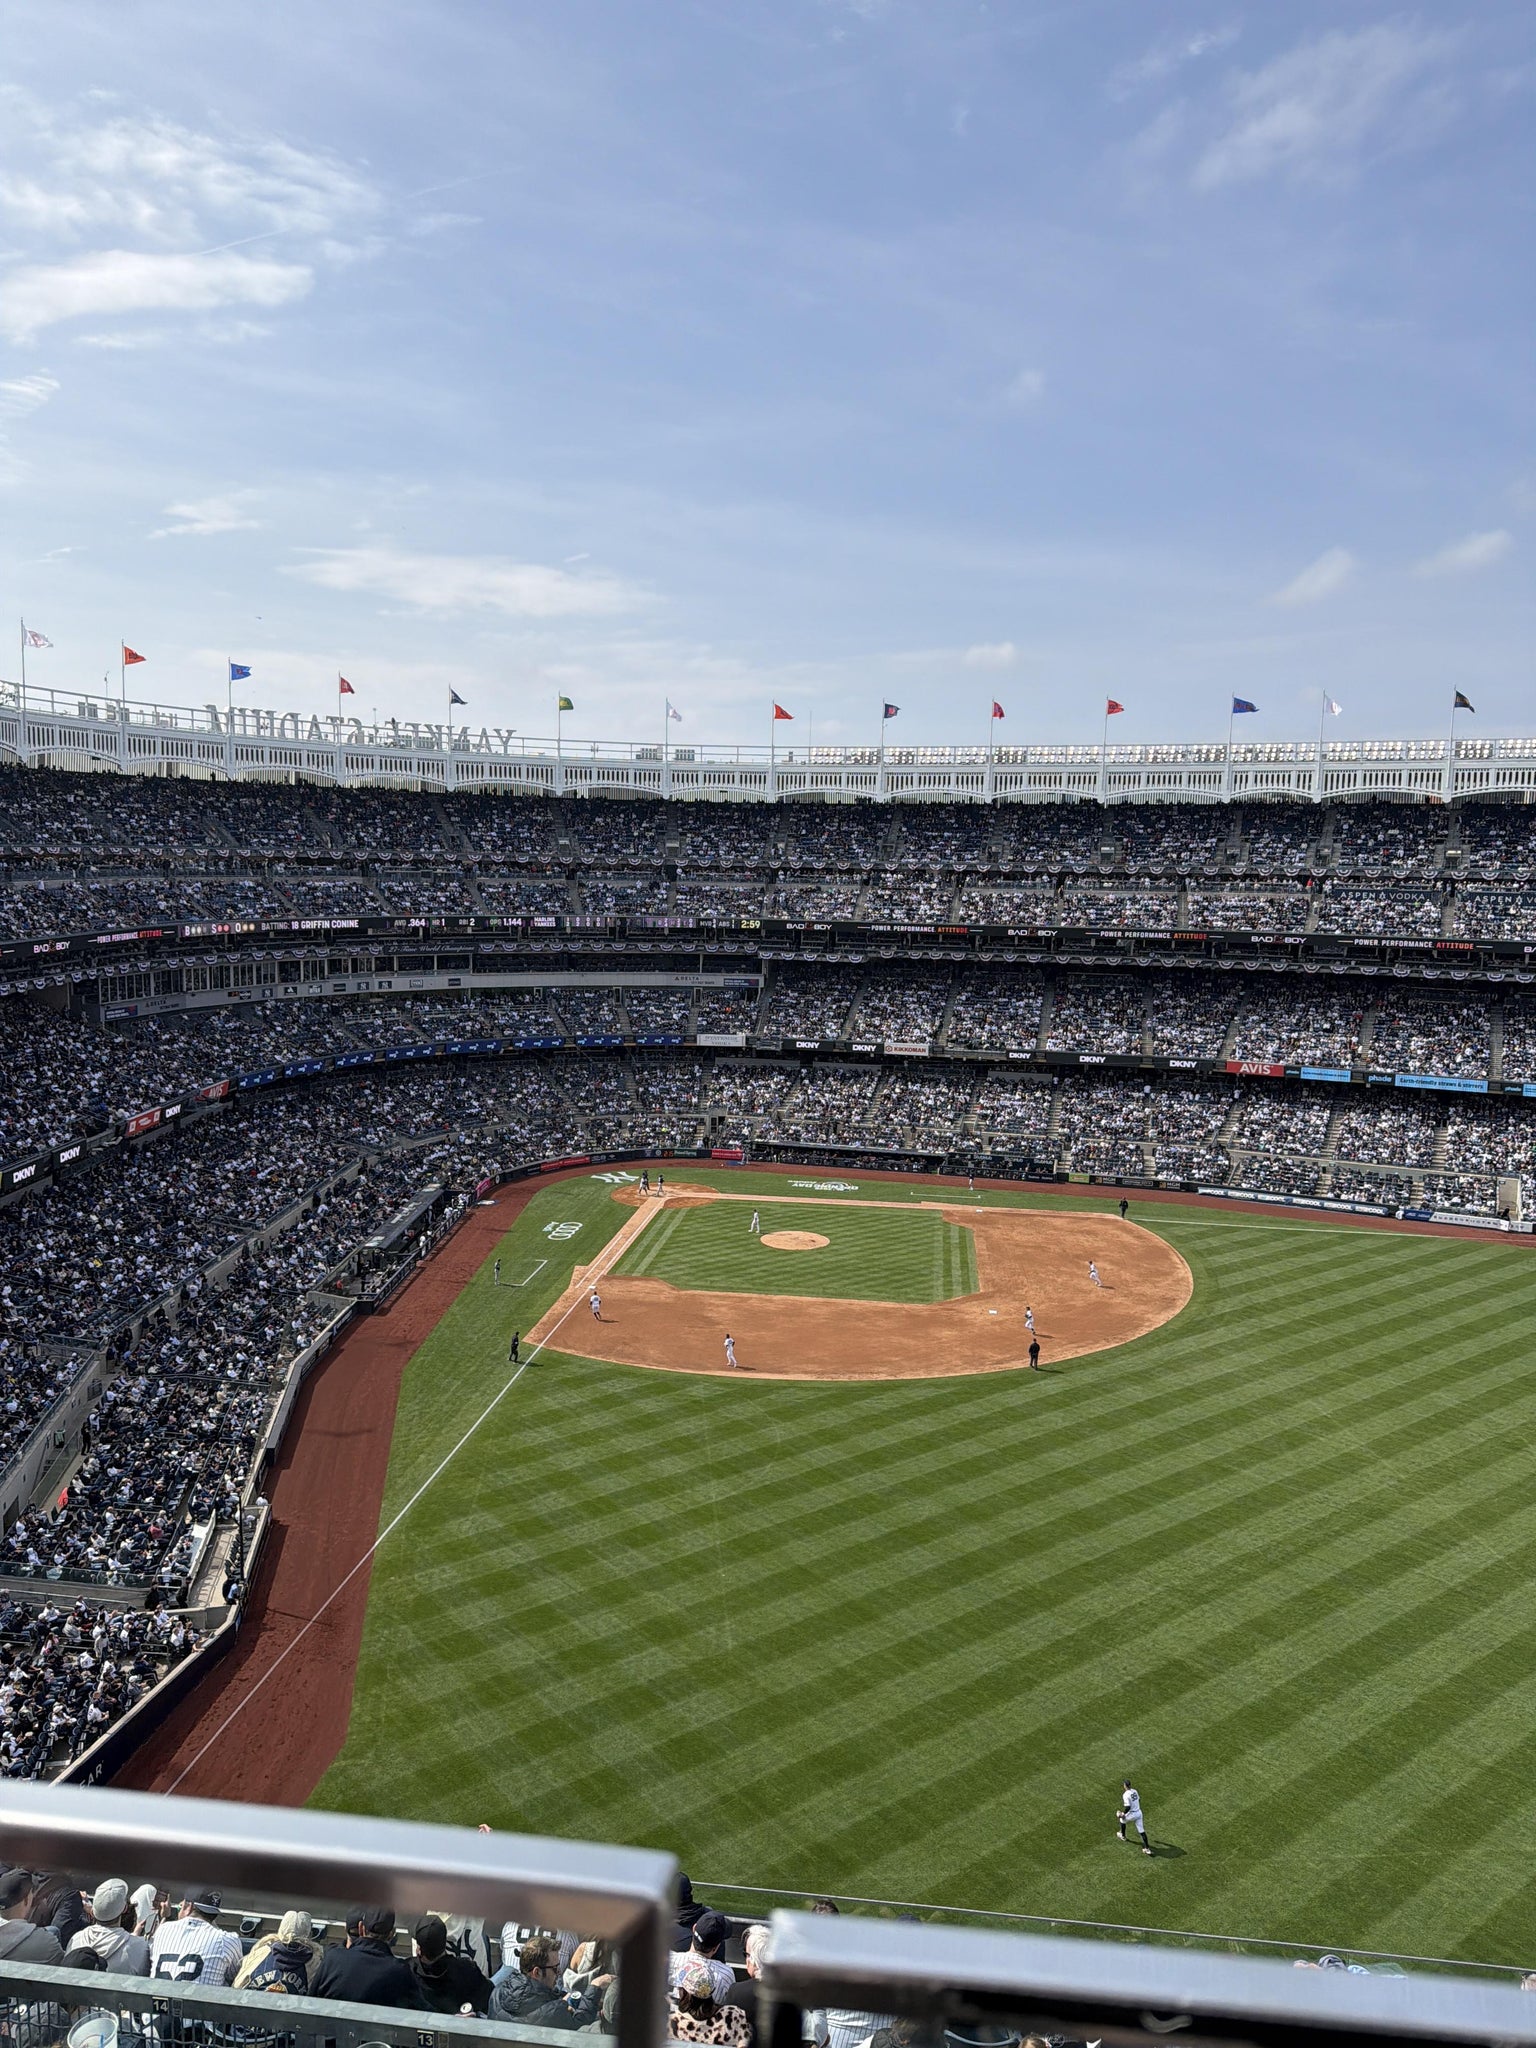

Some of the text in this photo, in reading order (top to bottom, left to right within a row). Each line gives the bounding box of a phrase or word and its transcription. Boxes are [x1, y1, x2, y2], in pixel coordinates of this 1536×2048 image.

[291, 921, 299, 930] 18
[301, 920, 330, 929] GRIFFIN
[331, 920, 359, 928] CONINE
[408, 919, 426, 927] .364
[470, 918, 475, 926] 2
[503, 918, 522, 926] 1.144
[741, 920, 760, 928] 2:59
[184, 925, 190, 936] B
[211, 925, 217, 934] S
[1251, 935, 1307, 944] BAD BOY
[33, 941, 70, 953] BAD BOY
[1436, 942, 1474, 950] ATTITUDE
[796, 1041, 820, 1049] DKNY
[852, 1044, 876, 1052] DKNY
[1079, 1055, 1106, 1063] DKNY
[1169, 1060, 1197, 1068] DKNY
[1240, 1063, 1271, 1075] AVIS
[1368, 1075, 1392, 1083] phade
[208, 1084, 223, 1098] AVIS
[165, 1104, 181, 1118] DKNY
[60, 1146, 80, 1163] DKNY
[13, 1164, 36, 1183] DKNY
[153, 2000, 169, 2012] 14
[418, 2034, 433, 2046] 13
